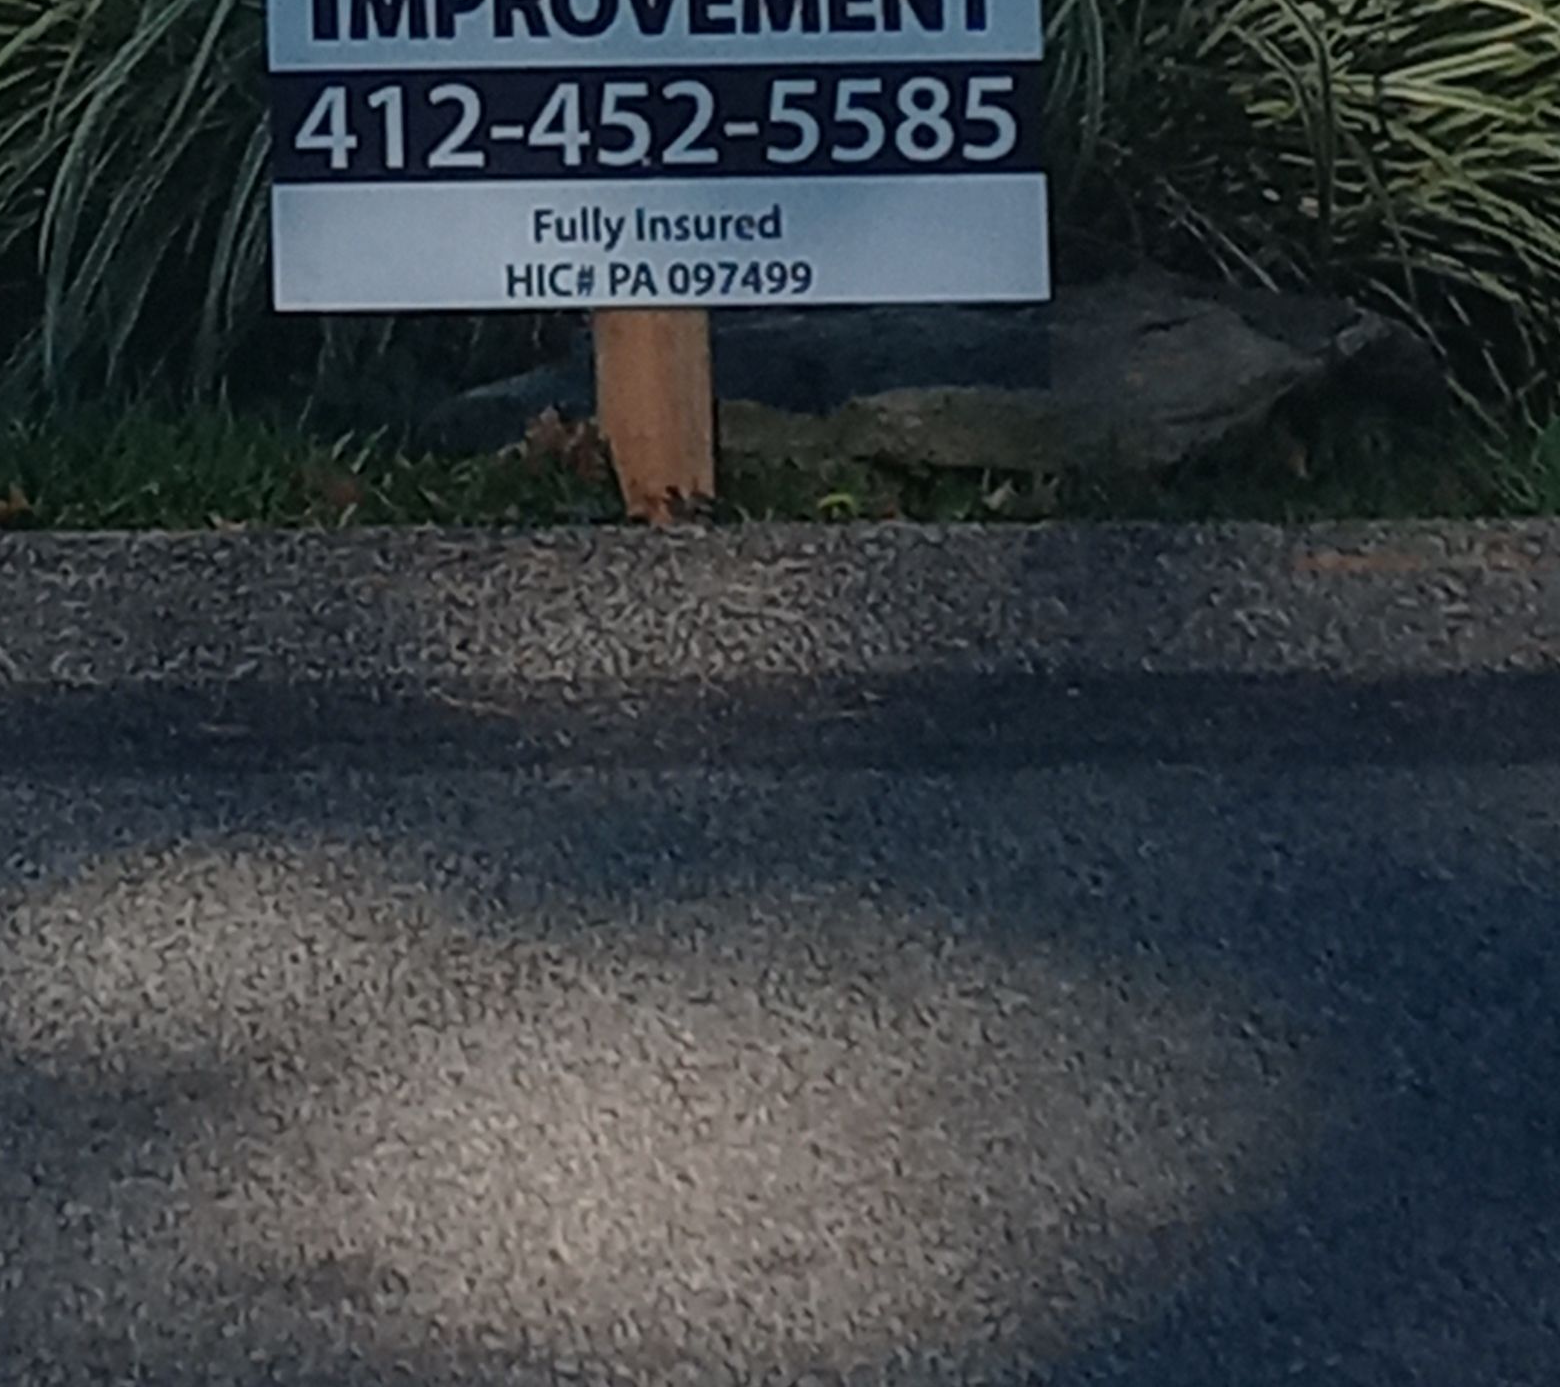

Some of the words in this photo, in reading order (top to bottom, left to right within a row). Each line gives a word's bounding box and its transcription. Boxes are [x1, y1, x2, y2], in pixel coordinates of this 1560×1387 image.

[294, 75, 1017, 170] 412-452-5585
[533, 206, 626, 252] Fully
[635, 203, 782, 242] Insured
[505, 263, 596, 298] HIC#
[609, 262, 658, 297] PA
[667, 261, 813, 295] 097499
